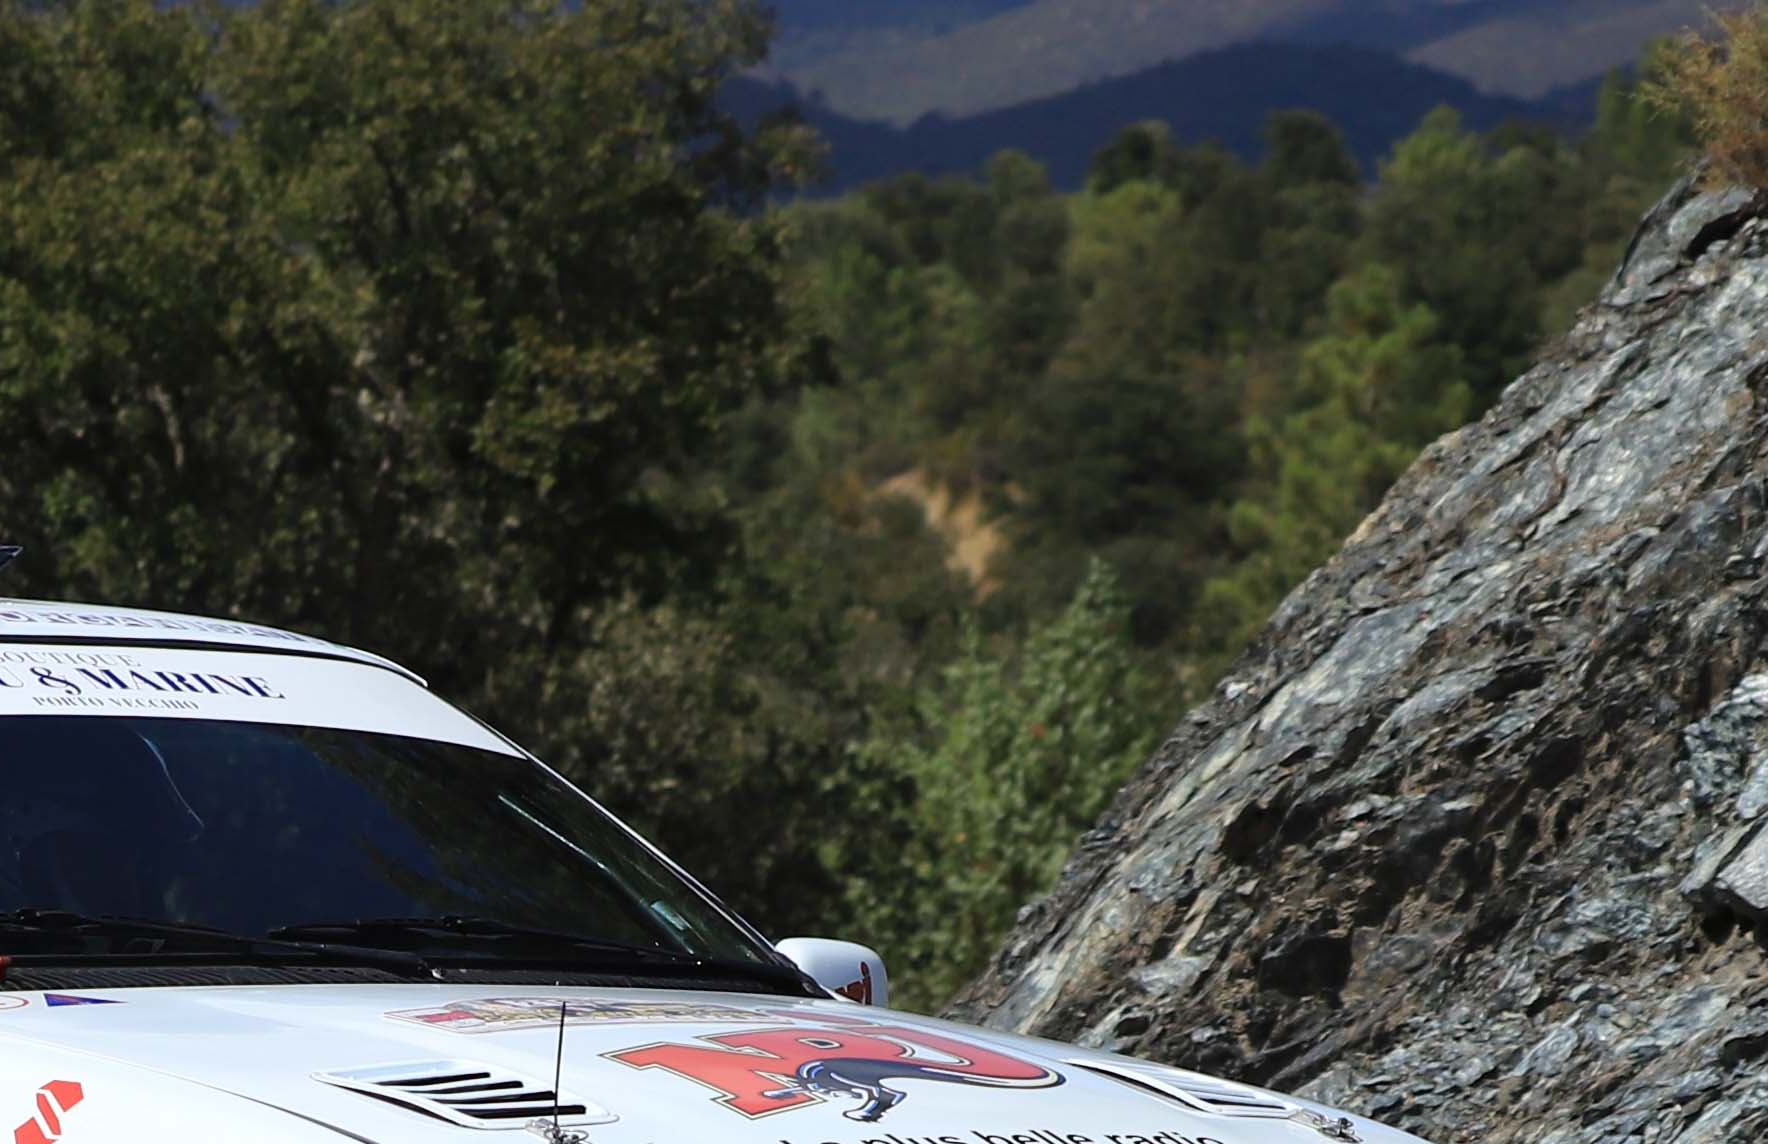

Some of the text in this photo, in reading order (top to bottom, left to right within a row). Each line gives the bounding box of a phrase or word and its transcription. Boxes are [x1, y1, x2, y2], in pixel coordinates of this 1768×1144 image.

[32, 666, 83, 695] &
[80, 668, 286, 699] MARINE
[32, 697, 199, 712] PORTO VECCHIO
